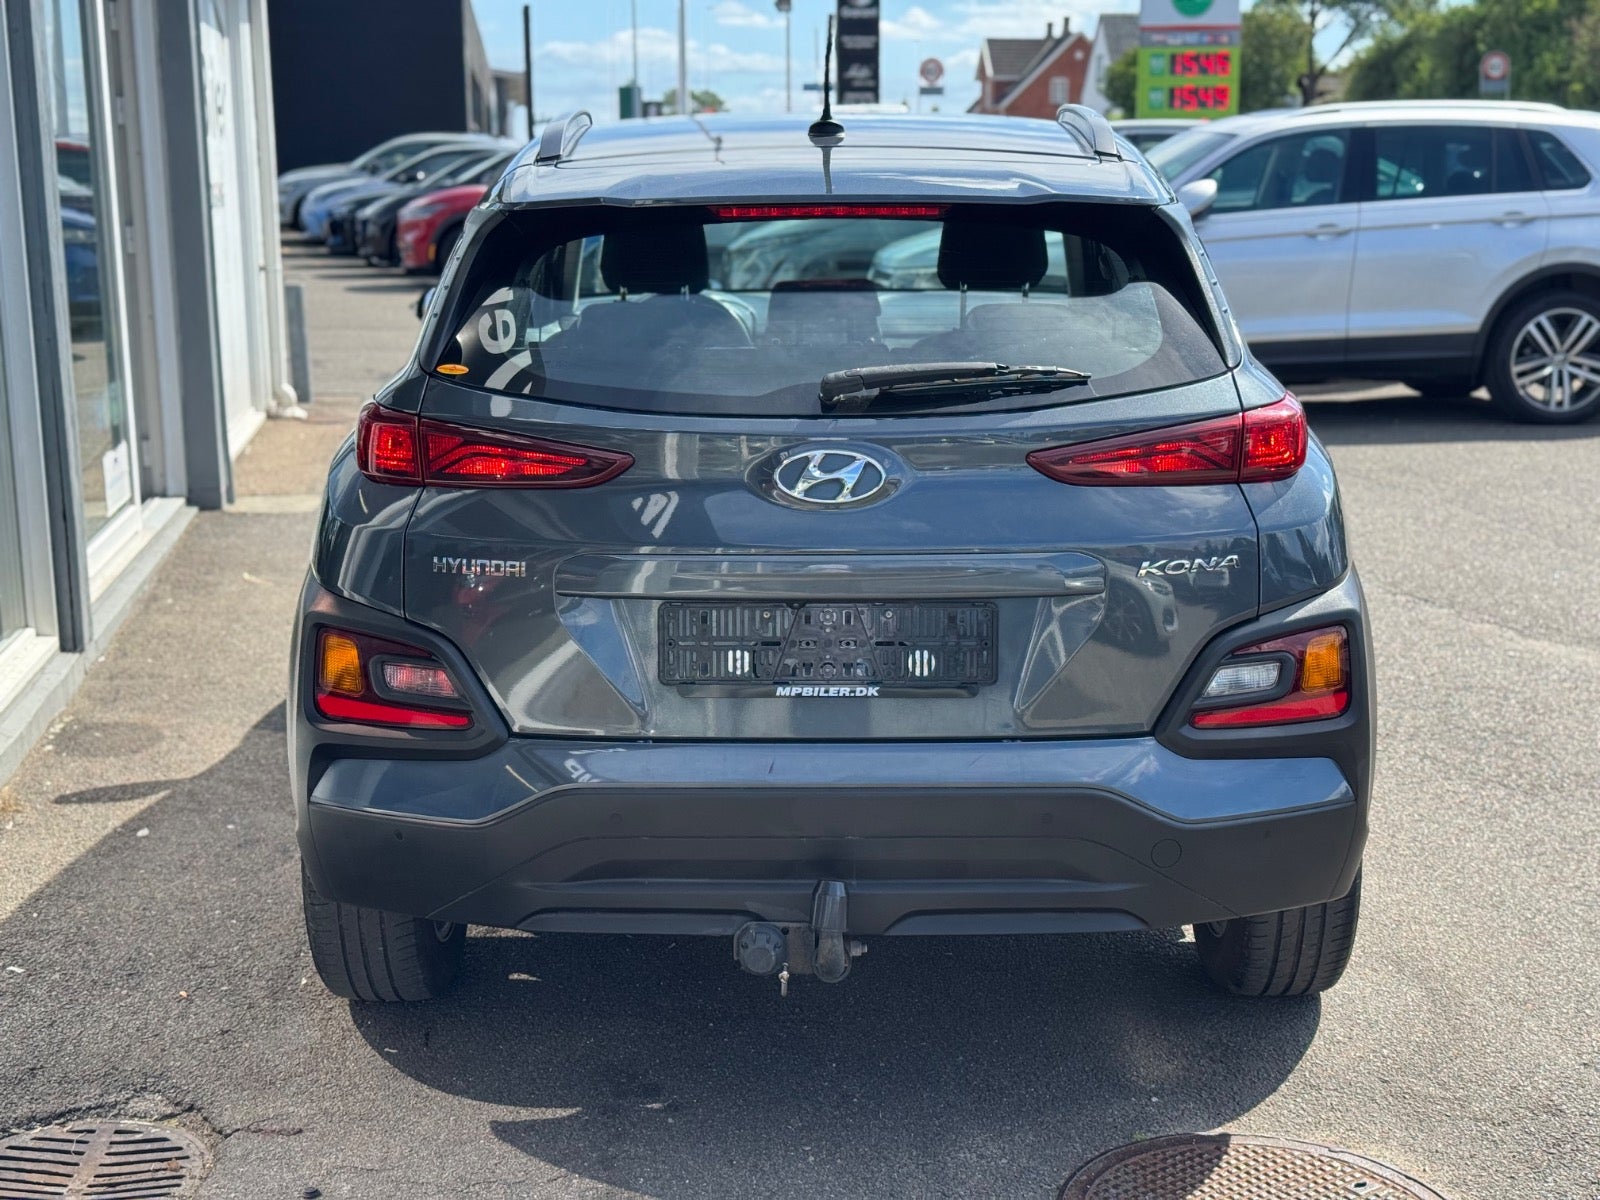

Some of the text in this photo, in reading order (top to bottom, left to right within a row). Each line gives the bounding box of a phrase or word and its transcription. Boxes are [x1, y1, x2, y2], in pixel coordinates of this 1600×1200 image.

[432, 556, 527, 577] HYUNDAI
[1136, 554, 1240, 577] KONA
[775, 686, 881, 697] MPBILER.DK
